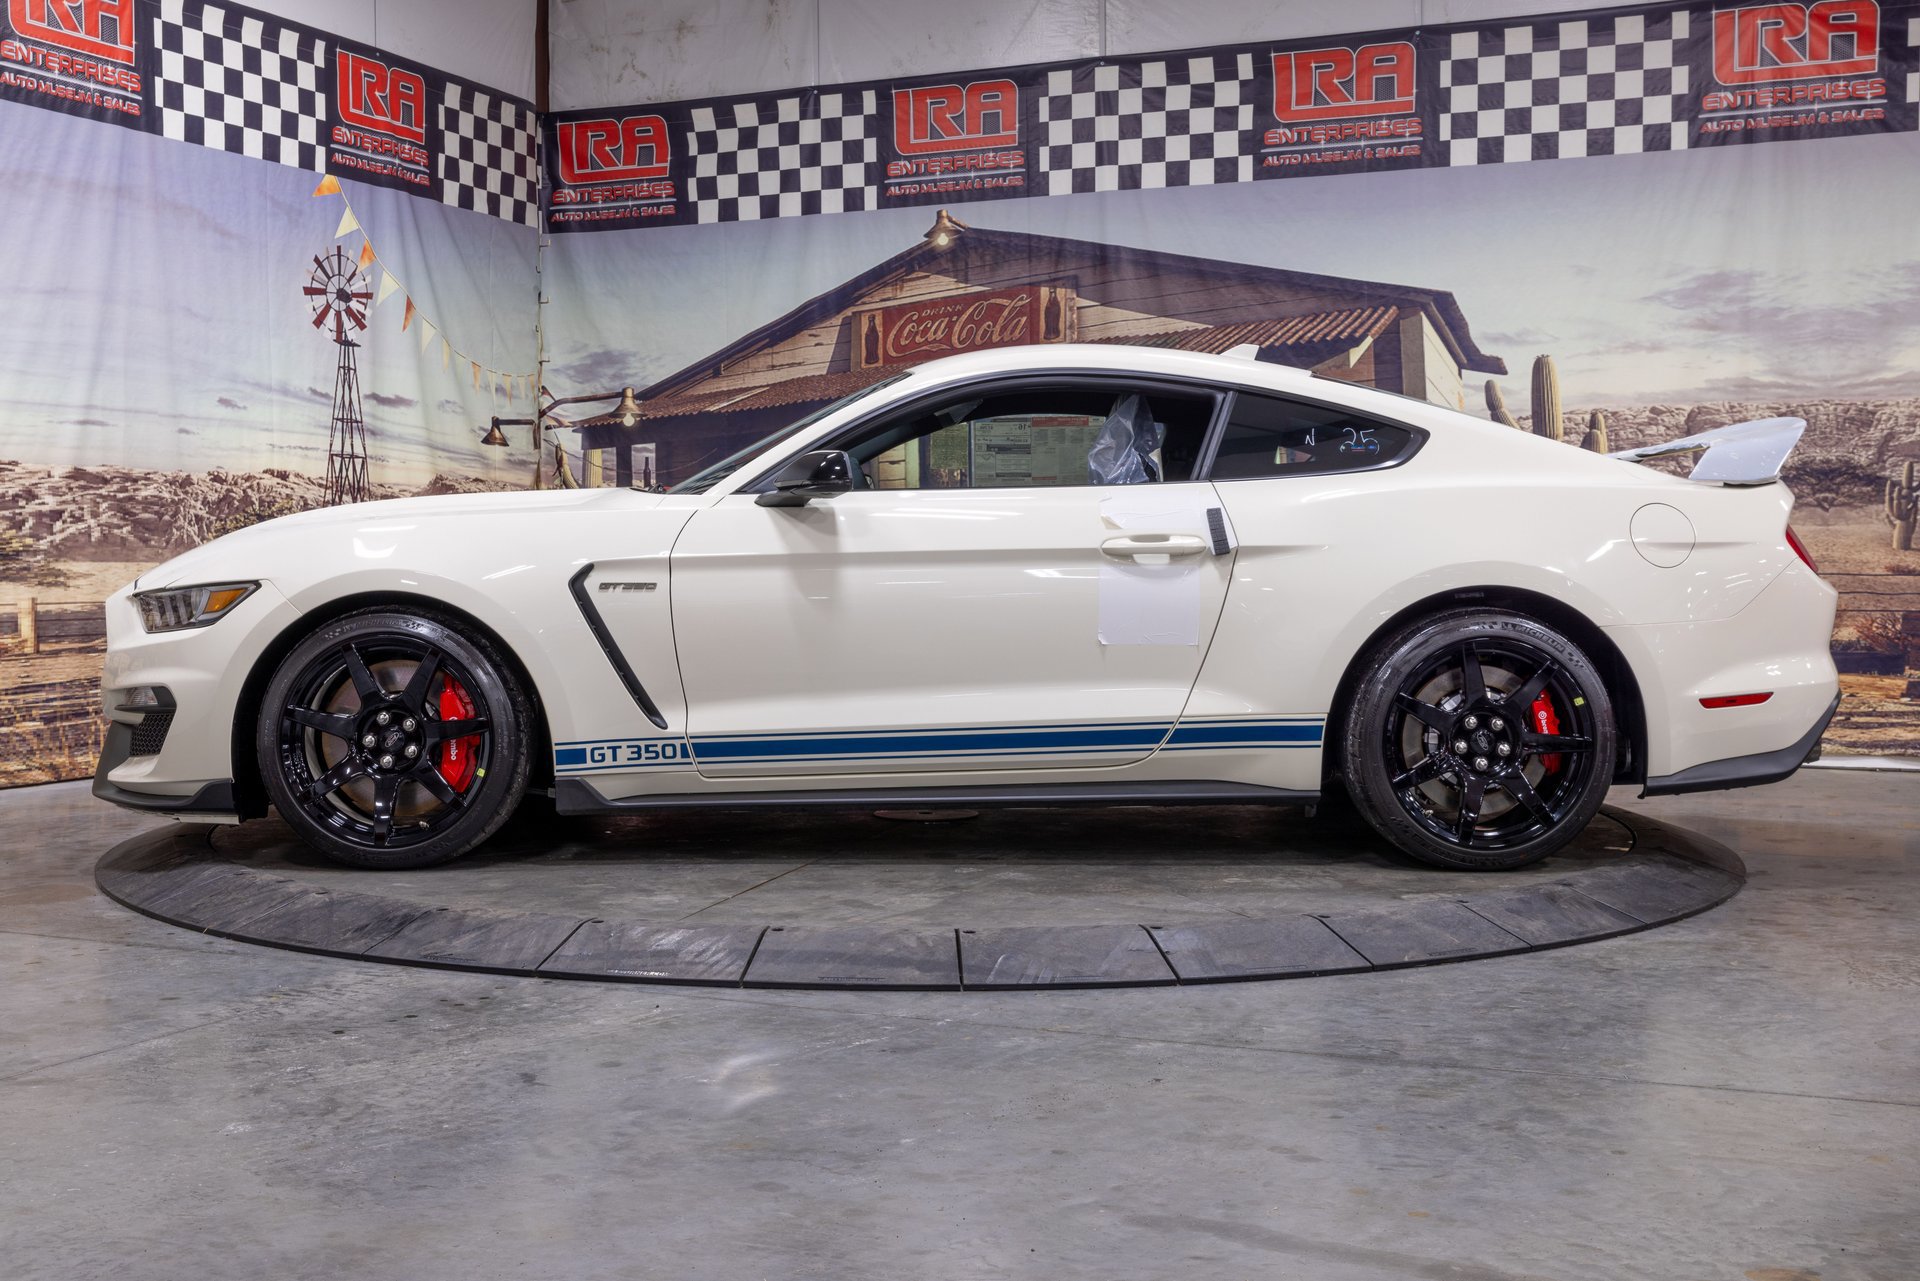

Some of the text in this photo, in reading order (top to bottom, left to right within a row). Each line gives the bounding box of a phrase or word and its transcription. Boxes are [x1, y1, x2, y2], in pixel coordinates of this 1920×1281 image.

[0, 39, 141, 92] ENTERPRISES
[0, 71, 140, 116] AUTO MUSEUM & SALES
[1702, 78, 1886, 111] ENTERPRISES
[1264, 118, 1423, 145] ENTERPRISES
[1700, 108, 1885, 133] AUTO MUSEUM & SALES
[332, 125, 429, 167] ENTERPRISES
[1263, 145, 1421, 167] AUTO MUSEUM & SALES
[332, 152, 357, 168] AUTO
[887, 151, 1024, 177] ENTERPRISES
[553, 181, 675, 204] ENTERPRISES
[887, 176, 1024, 196] AUTO MUSEUM & SALES
[552, 211, 583, 222] AUTO
[632, 207, 640, 217] &
[641, 205, 676, 216] SALES
[921, 303, 964, 317] DRINK
[1340, 428, 1379, 456] 25
[1515, 625, 1566, 654] MICHELIN
